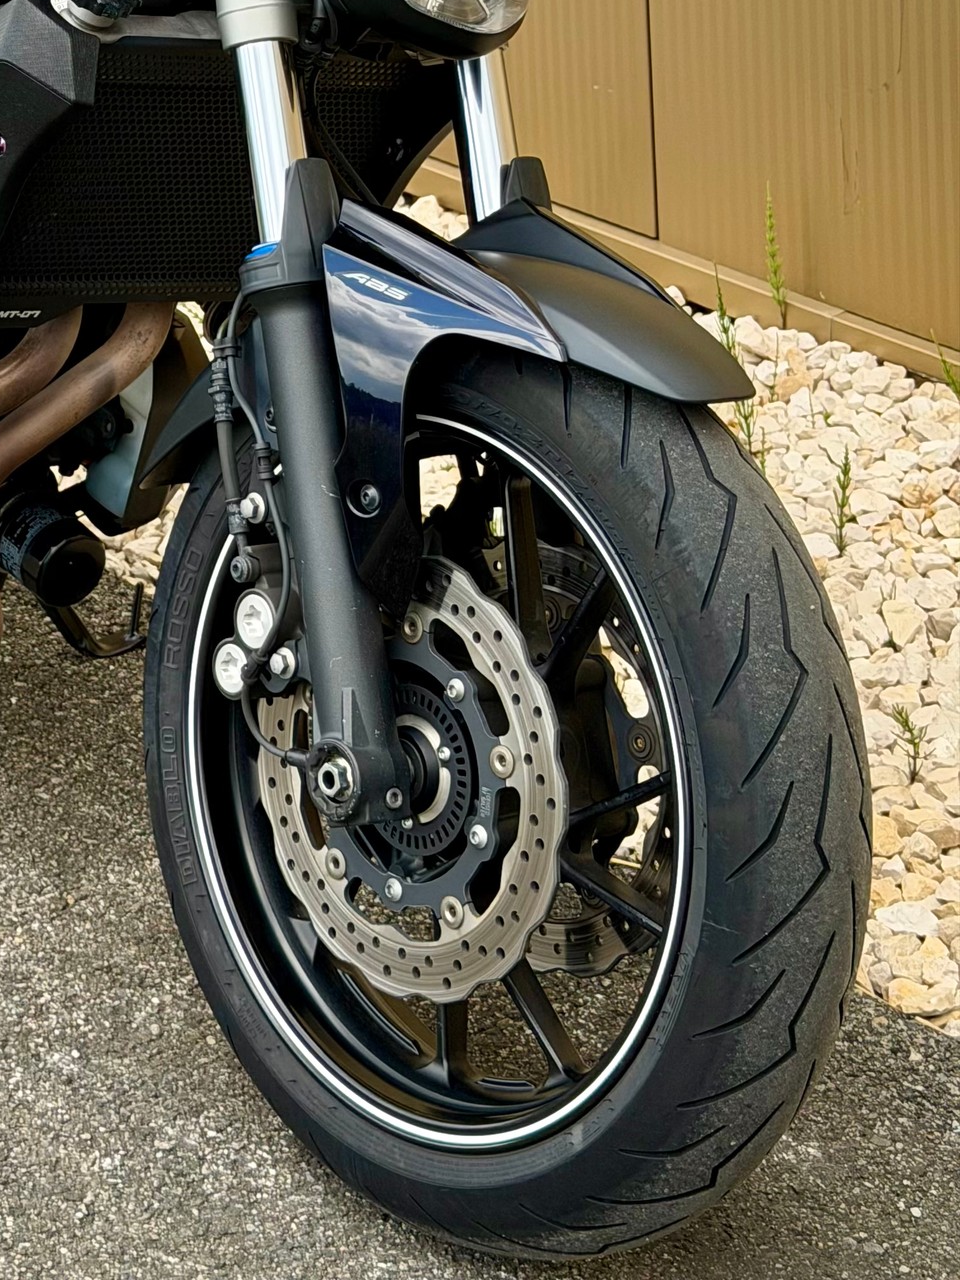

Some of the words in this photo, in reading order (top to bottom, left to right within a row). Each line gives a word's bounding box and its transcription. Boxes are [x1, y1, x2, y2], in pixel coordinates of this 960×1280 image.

[341, 272, 410, 301] ABS
[163, 546, 203, 670] ROSSO
[159, 725, 199, 887] DIABLO
